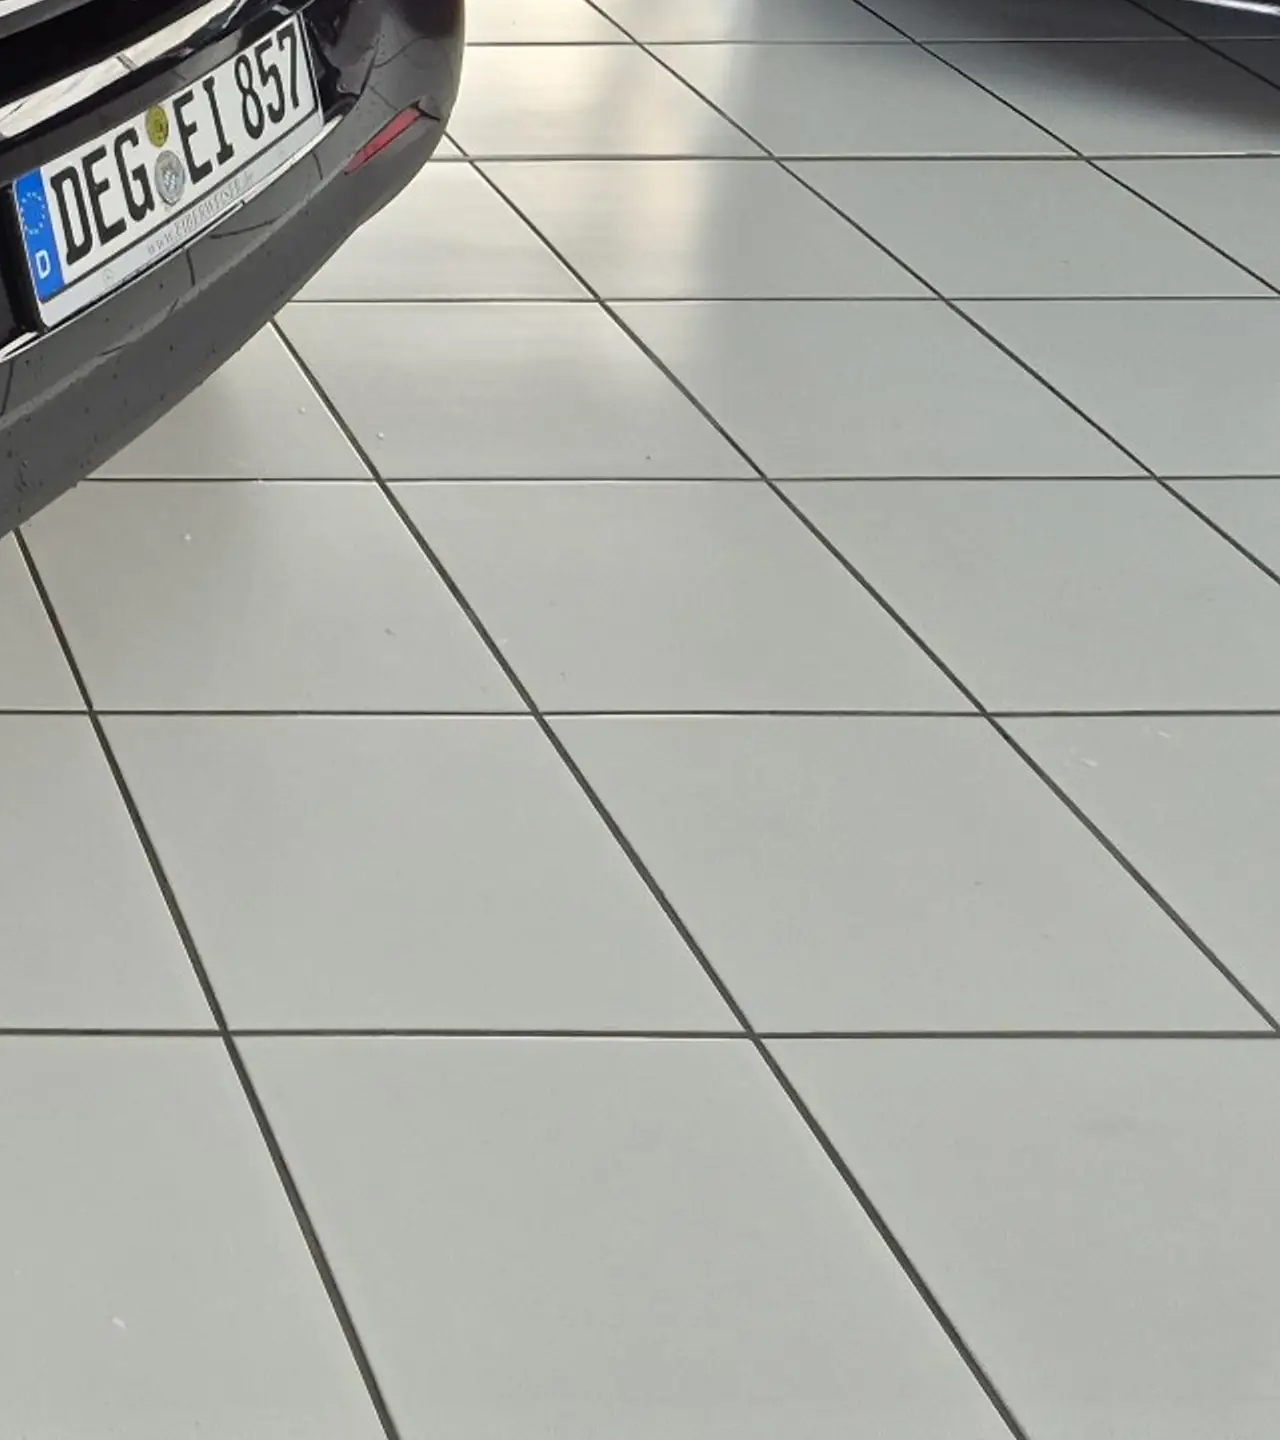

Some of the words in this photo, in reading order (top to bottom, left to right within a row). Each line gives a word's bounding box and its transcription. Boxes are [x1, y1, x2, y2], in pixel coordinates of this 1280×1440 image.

[50, 127, 155, 266] DEG
[172, 76, 234, 185] EI
[234, 26, 300, 140] 857
[35, 249, 51, 279] D
